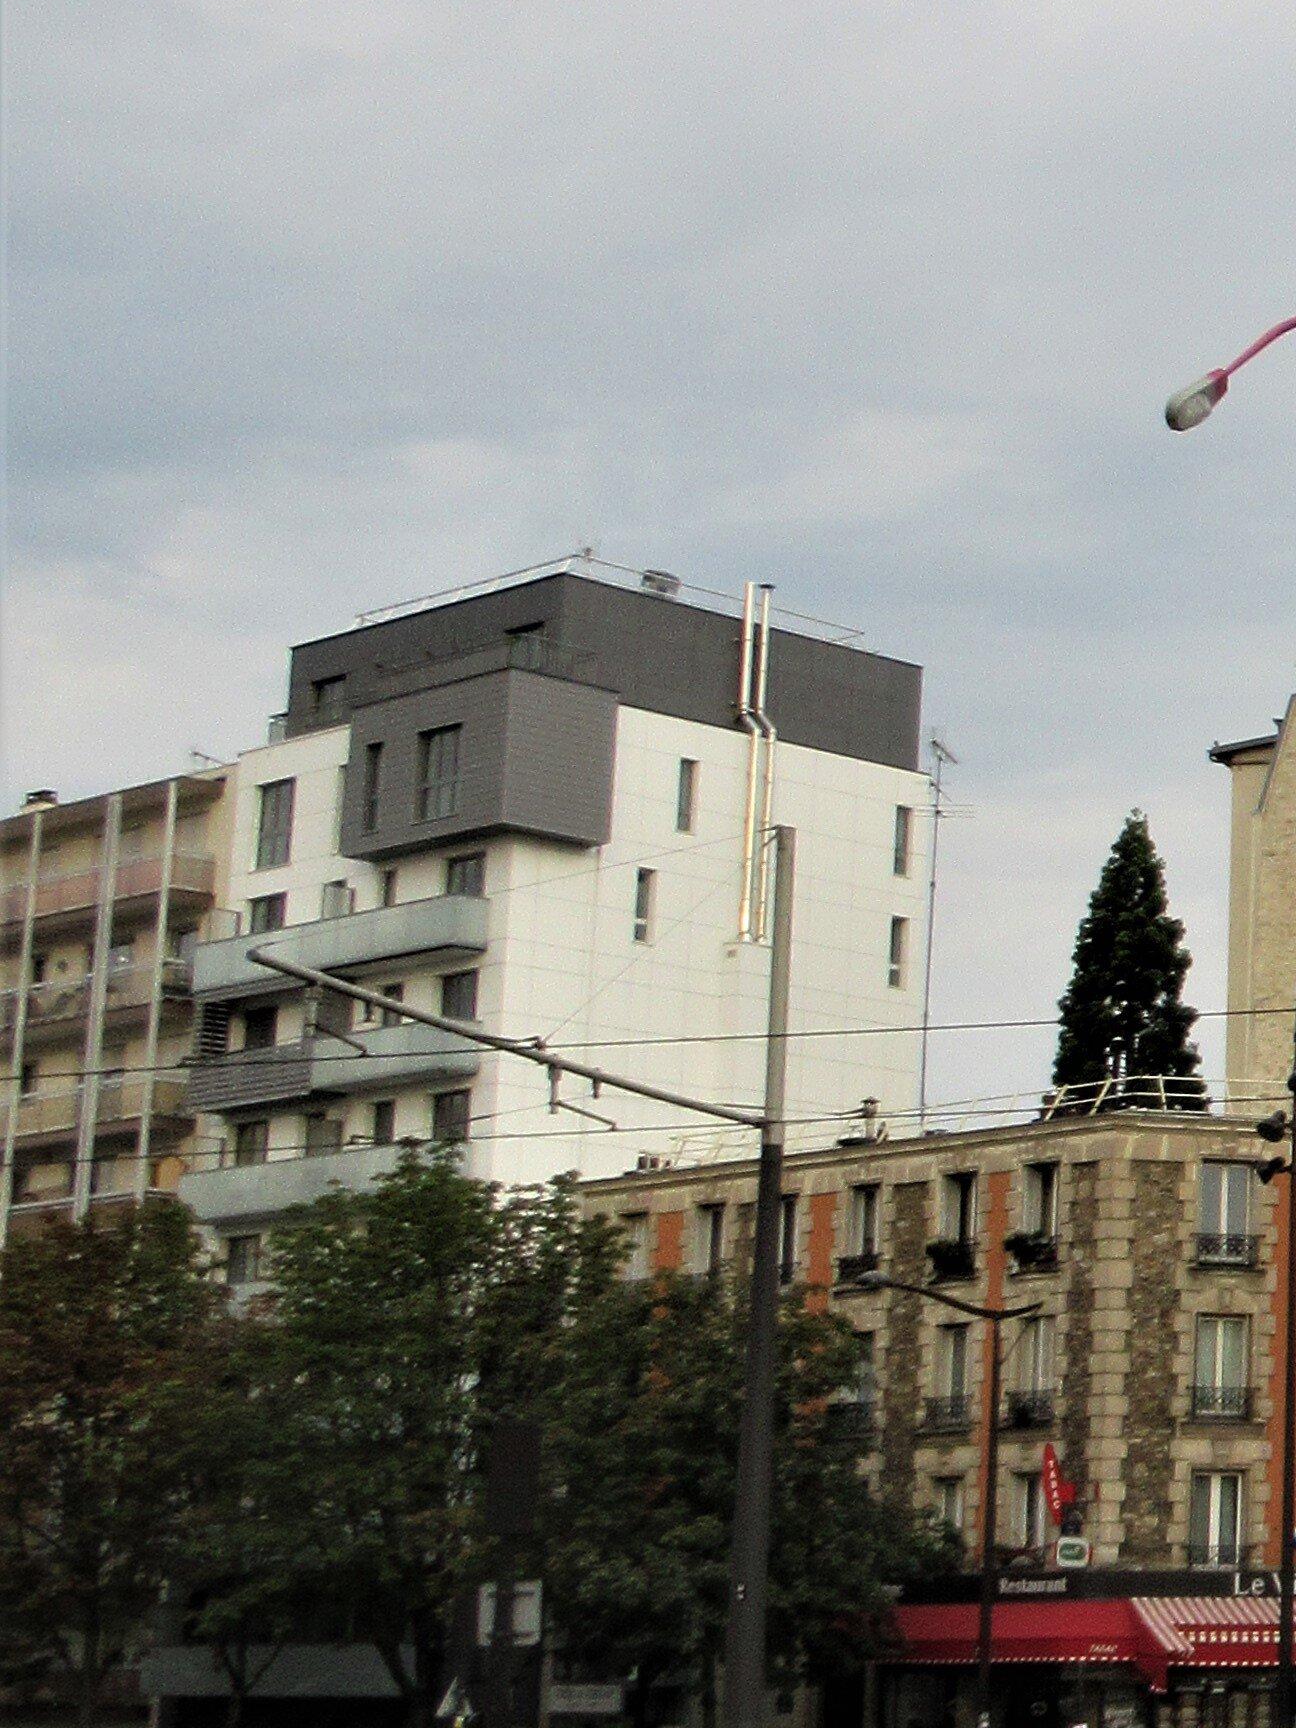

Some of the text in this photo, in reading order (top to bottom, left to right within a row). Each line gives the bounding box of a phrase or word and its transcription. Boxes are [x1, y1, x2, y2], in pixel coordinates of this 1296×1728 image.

[1048, 1459, 1061, 1510] TABAC
[1000, 1576, 1068, 1595] Restaurant
[1234, 1572, 1266, 1596] Le
